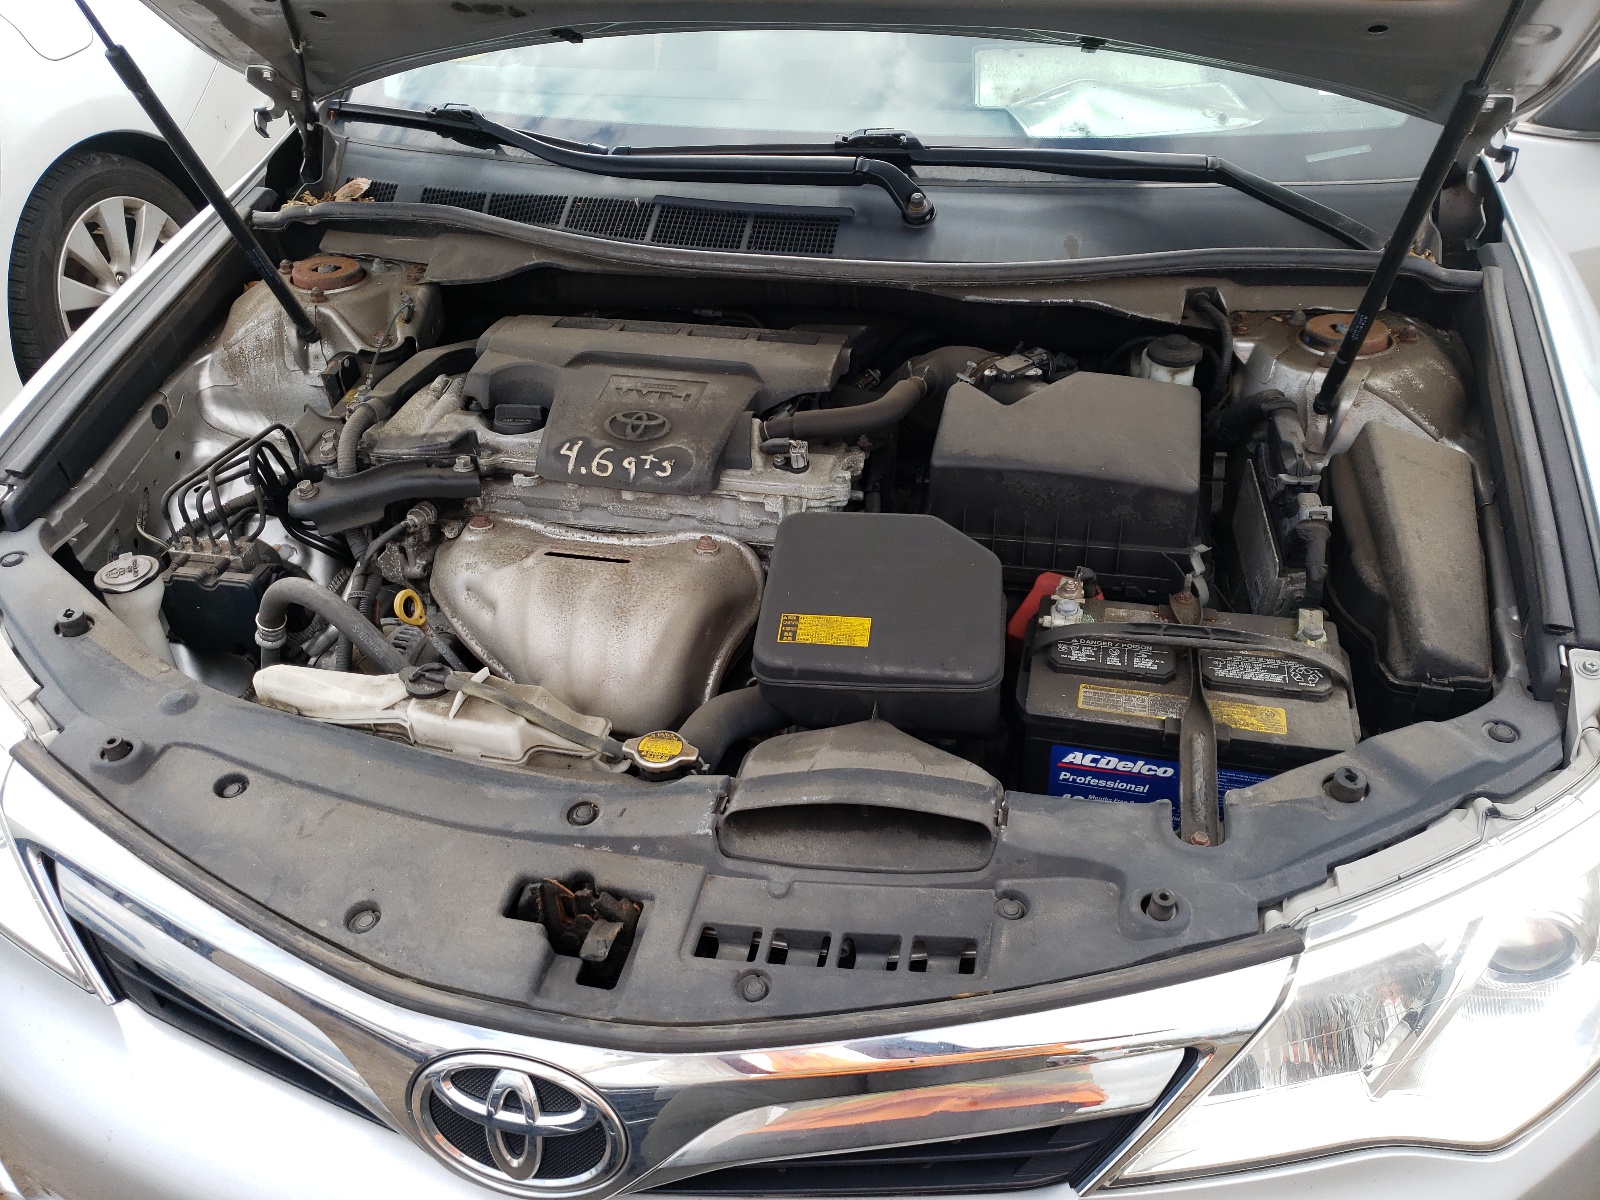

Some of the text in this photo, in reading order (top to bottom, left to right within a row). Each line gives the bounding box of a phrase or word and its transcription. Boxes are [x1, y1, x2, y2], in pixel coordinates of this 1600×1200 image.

[559, 440, 675, 483] 4.6 qts
[1079, 638, 1113, 647] DANGER
[1121, 643, 1153, 651] POISON
[1061, 751, 1175, 777] ACDelco
[1059, 771, 1150, 793] Professional
